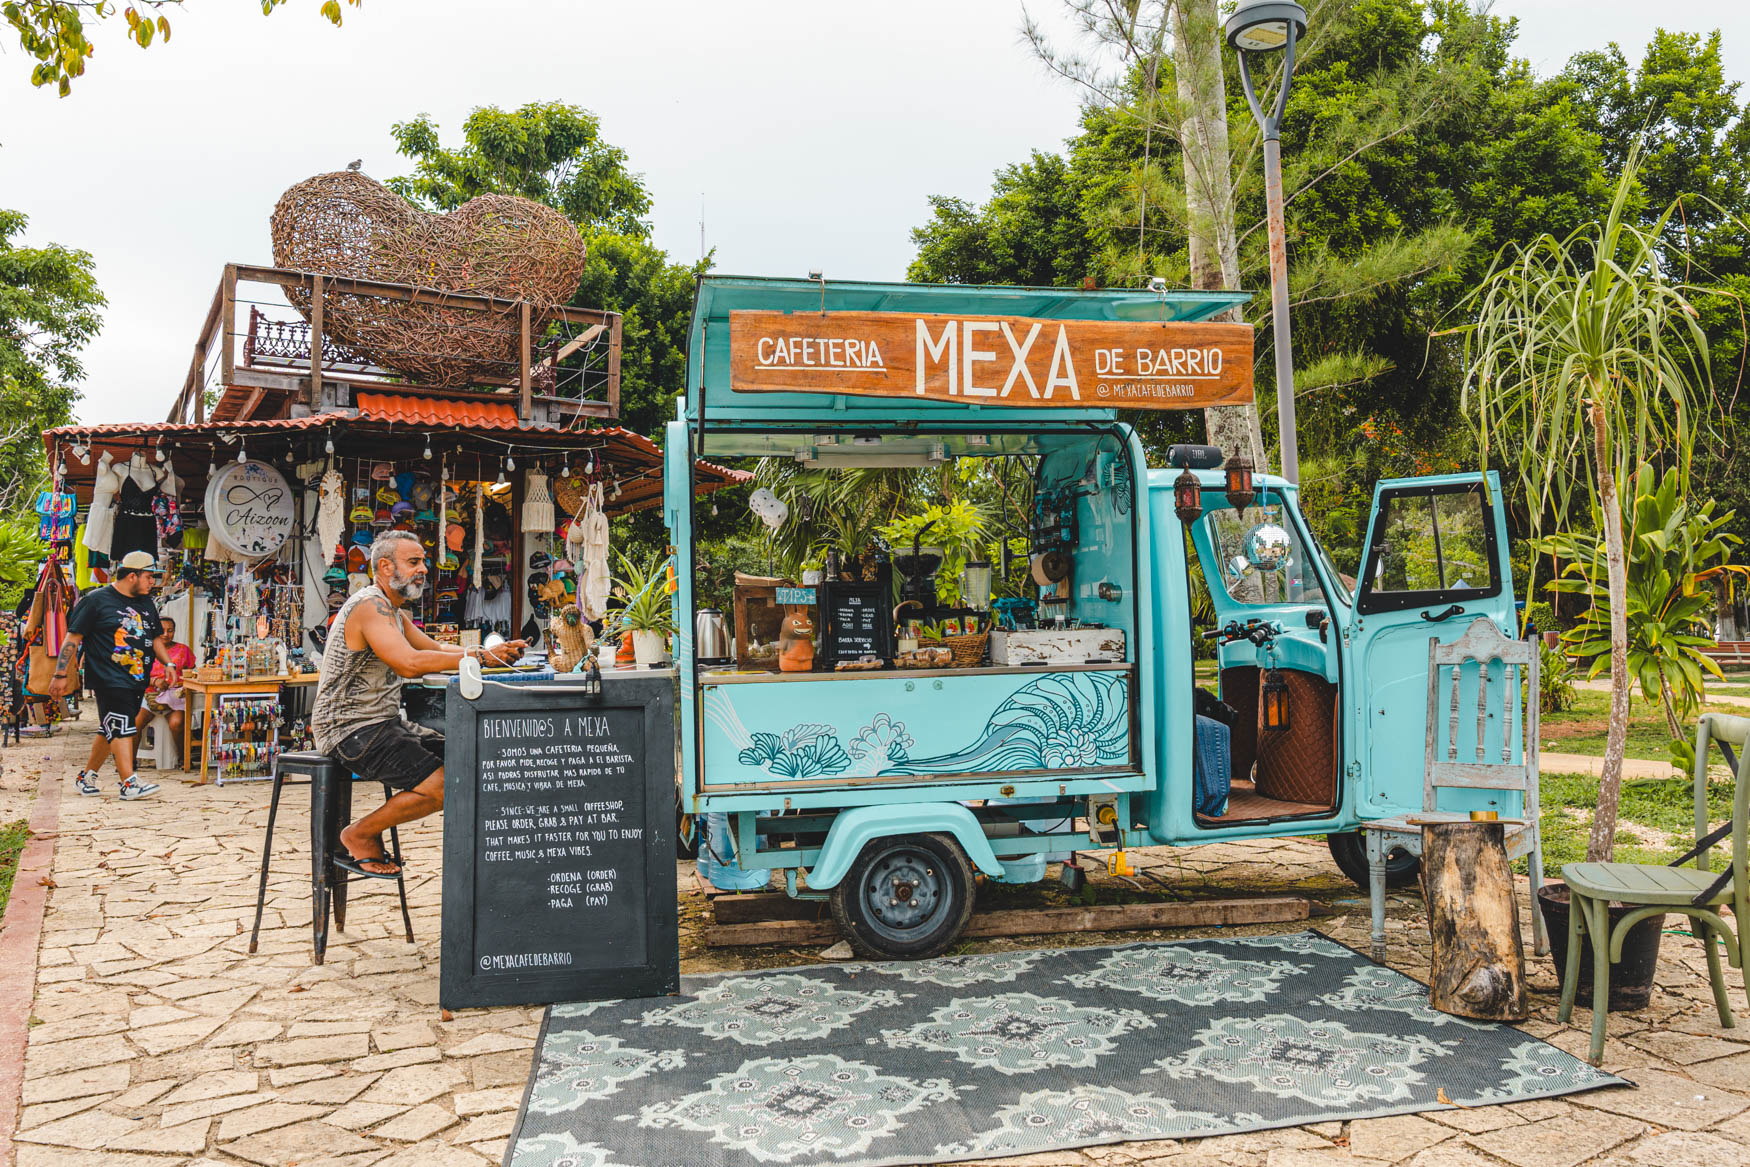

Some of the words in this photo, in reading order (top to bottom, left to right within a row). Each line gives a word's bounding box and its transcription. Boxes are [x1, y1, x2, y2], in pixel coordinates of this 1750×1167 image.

[758, 337, 883, 367] CAFETERIA
[916, 319, 1080, 400] MEXA
[1095, 349, 1124, 373] DE
[1137, 348, 1222, 375] BARRIO
[227, 507, 289, 526] Aizoon
[782, 590, 806, 602] TIPS
[484, 718, 554, 738] BIENVENID@S
[565, 718, 571, 736] A
[579, 717, 610, 736] MEXA
[530, 747, 542, 755] UNA
[545, 745, 582, 755] CAFETERIA
[483, 760, 494, 769] POR
[497, 759, 516, 768] FAVOR
[520, 758, 535, 768] PIDE,
[536, 758, 558, 766] RECOGE
[569, 756, 585, 765] PAGA
[483, 772, 494, 780] ASI
[498, 770, 520, 780] PODRAS
[524, 769, 559, 778] DISFRUTAR
[564, 768, 577, 777] MAS
[579, 767, 601, 776] RAPIDO
[533, 781, 551, 790] VIBRA
[561, 804, 578, 813] SMALL
[485, 819, 508, 831] PLEASE
[538, 817, 557, 828] GRAB
[560, 817, 567, 826] &
[569, 816, 583, 826] PAY
[587, 814, 597, 824] AT
[601, 813, 619, 823] BAR.
[486, 836, 504, 846] THAT
[508, 835, 530, 844] MAKES
[534, 833, 542, 842] IT
[545, 832, 572, 842] FASTER
[576, 831, 589, 841] FOR
[592, 830, 606, 841] YOU
[608, 829, 618, 840] TO
[622, 829, 642, 839] ENJOY
[485, 851, 513, 861] COFFEE,
[515, 850, 536, 859] MUSIC
[538, 850, 545, 858] &
[547, 847, 566, 857] MEXA
[569, 846, 592, 856] VIBES.
[587, 868, 616, 880] (ORDER)
[586, 881, 613, 892] (GRAB)
[586, 894, 608, 907] (PAY)
[480, 952, 572, 970] @MEXACAFEDEBARRIO
